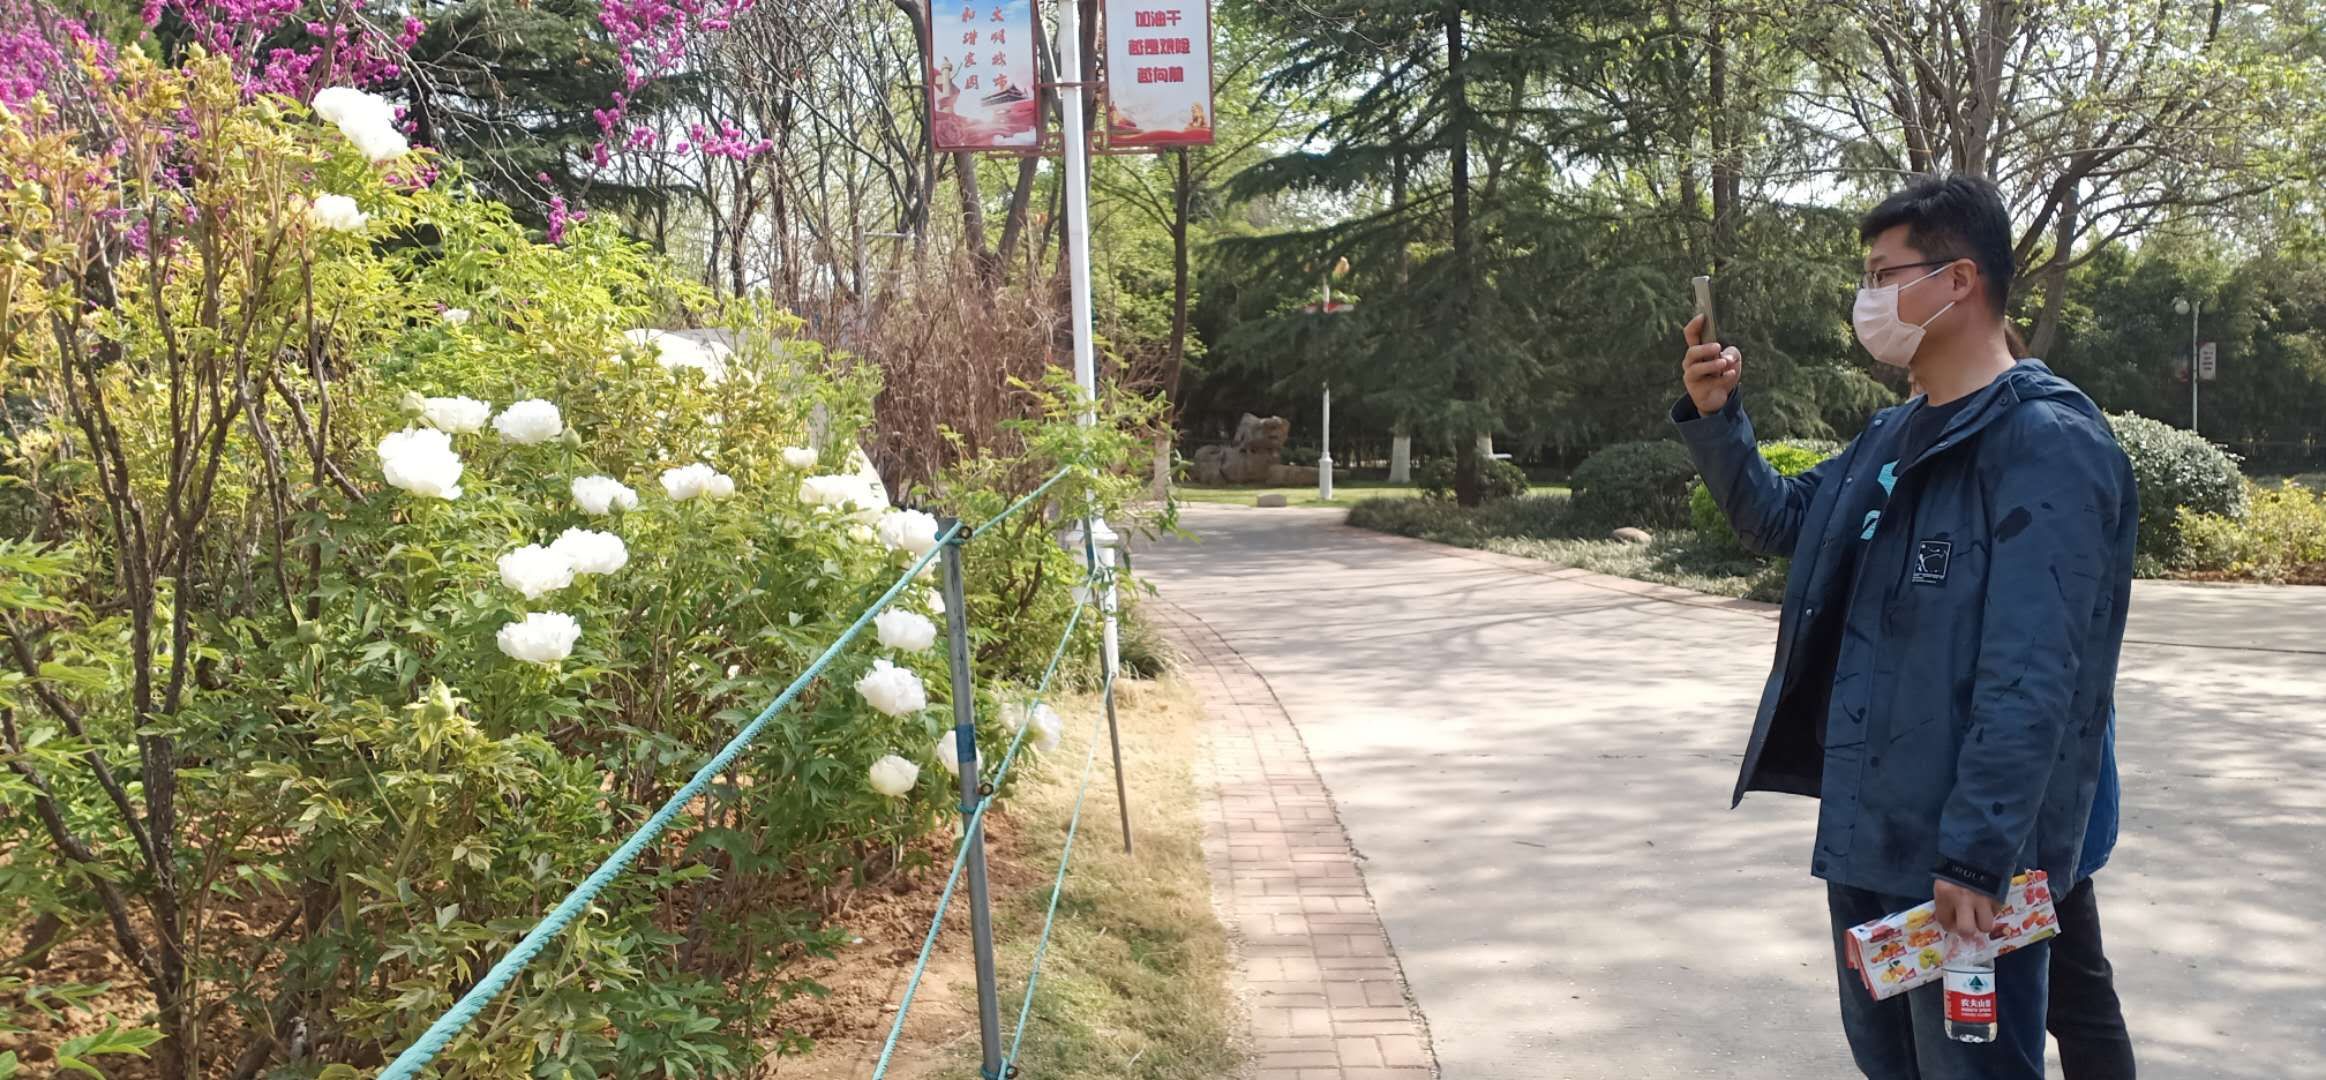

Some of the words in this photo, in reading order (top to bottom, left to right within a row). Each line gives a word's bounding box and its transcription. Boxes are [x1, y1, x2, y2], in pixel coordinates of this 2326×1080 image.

[1135, 9, 1182, 27] 加油干
[989, 5, 1008, 91] 文明城市
[1128, 37, 1190, 56] 越是艰险
[1137, 66, 1184, 84] 越向前
